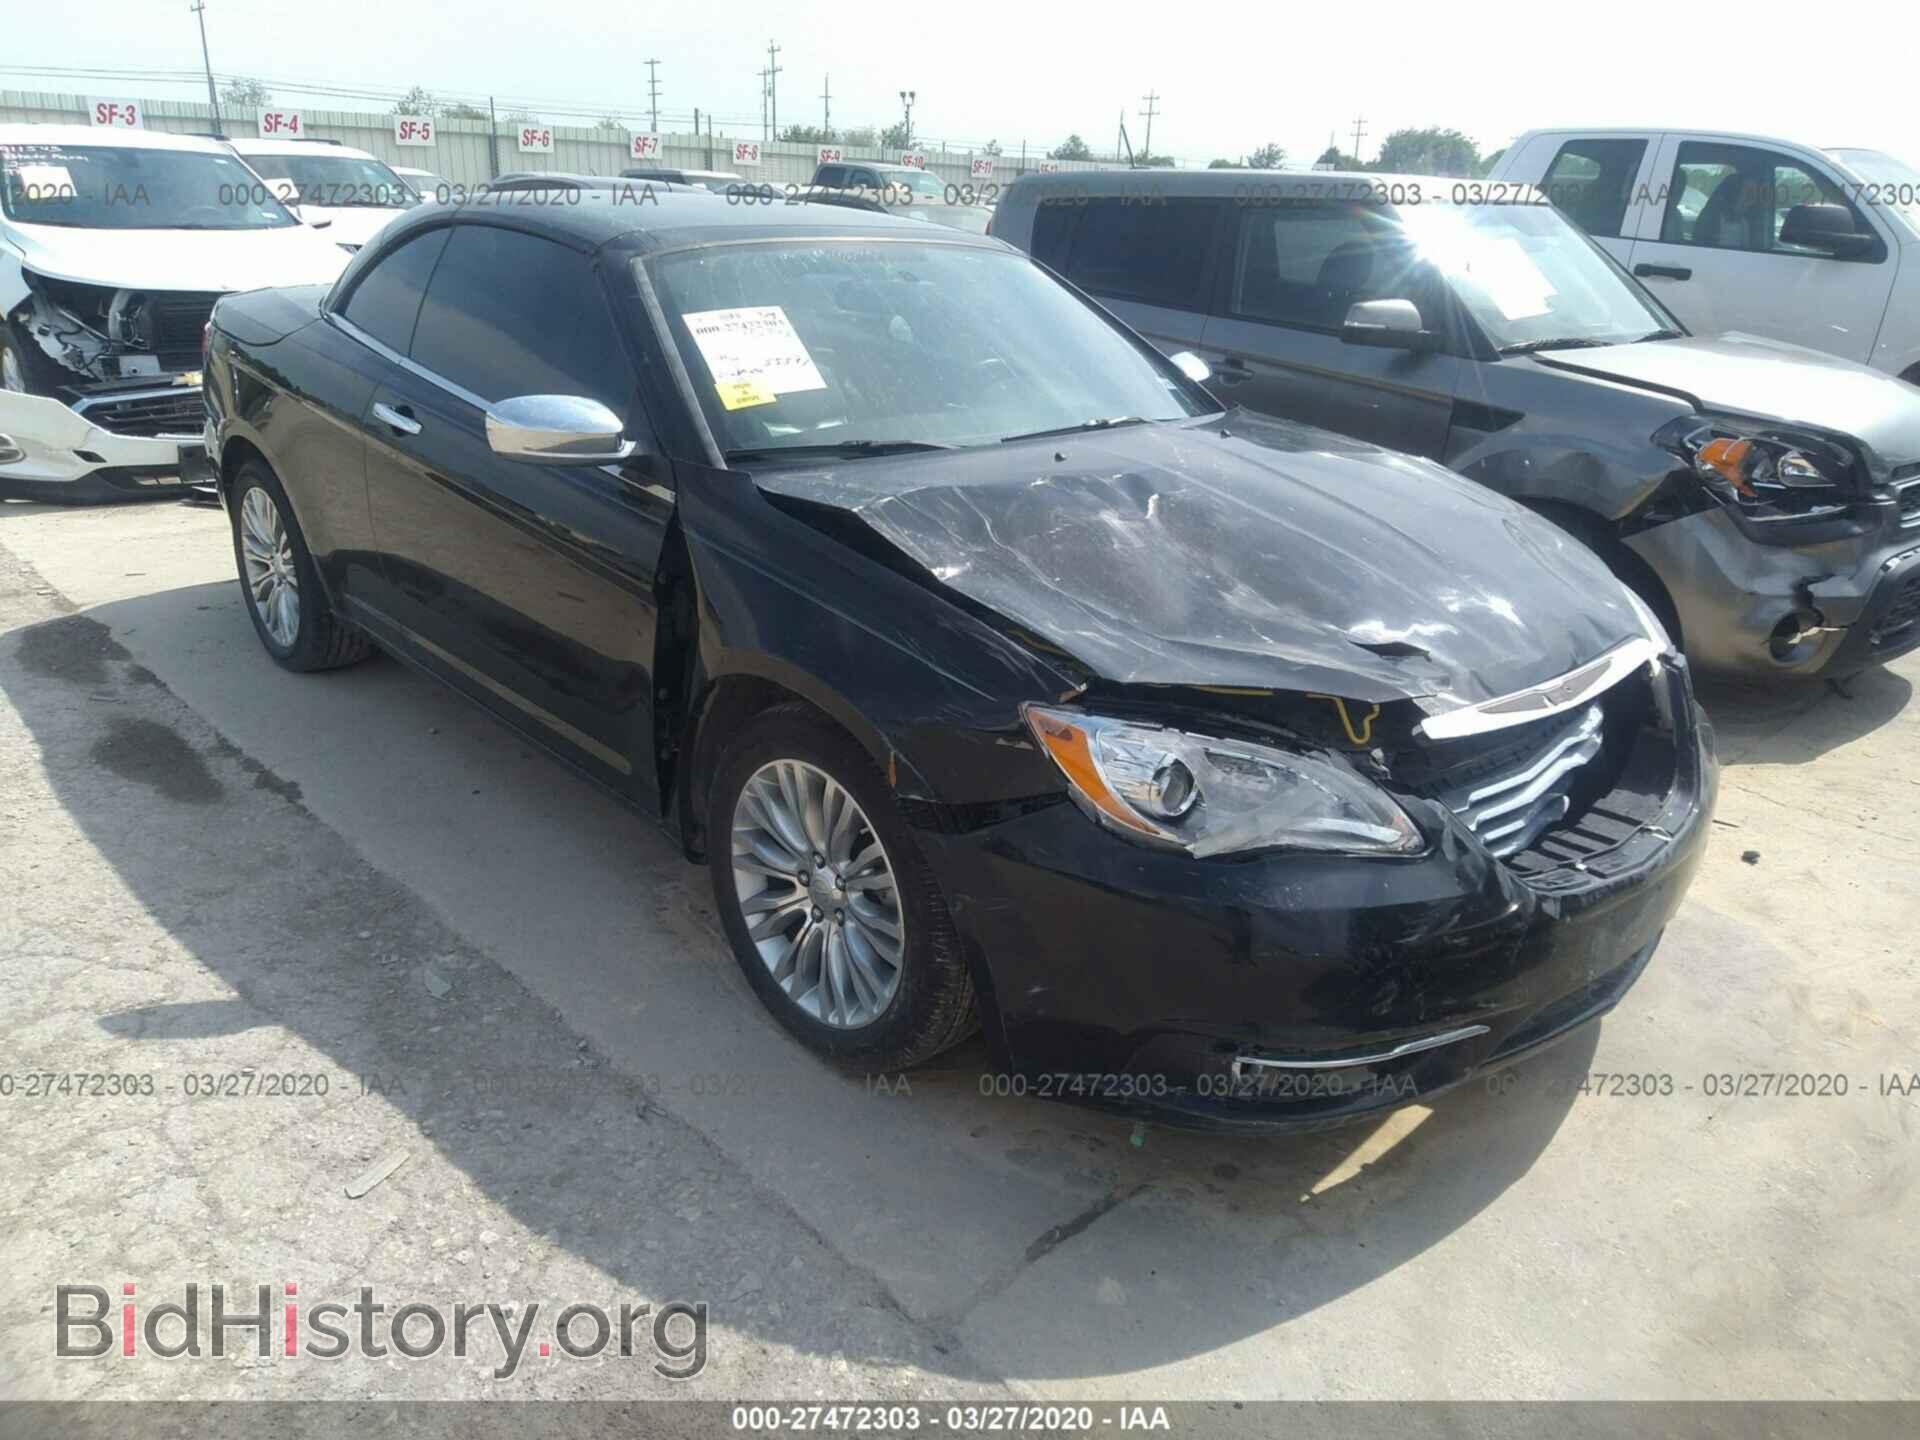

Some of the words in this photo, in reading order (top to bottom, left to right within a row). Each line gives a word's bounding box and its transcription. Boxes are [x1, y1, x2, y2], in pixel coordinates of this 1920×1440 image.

[96, 102, 136, 126] SF-3
[263, 113, 298, 134] SF-4
[399, 120, 430, 141] SF-5
[522, 128, 550, 149] SF-6
[633, 136, 658, 155] SF-7
[735, 143, 758, 160] SF-8
[972, 159, 993, 175] SF-11
